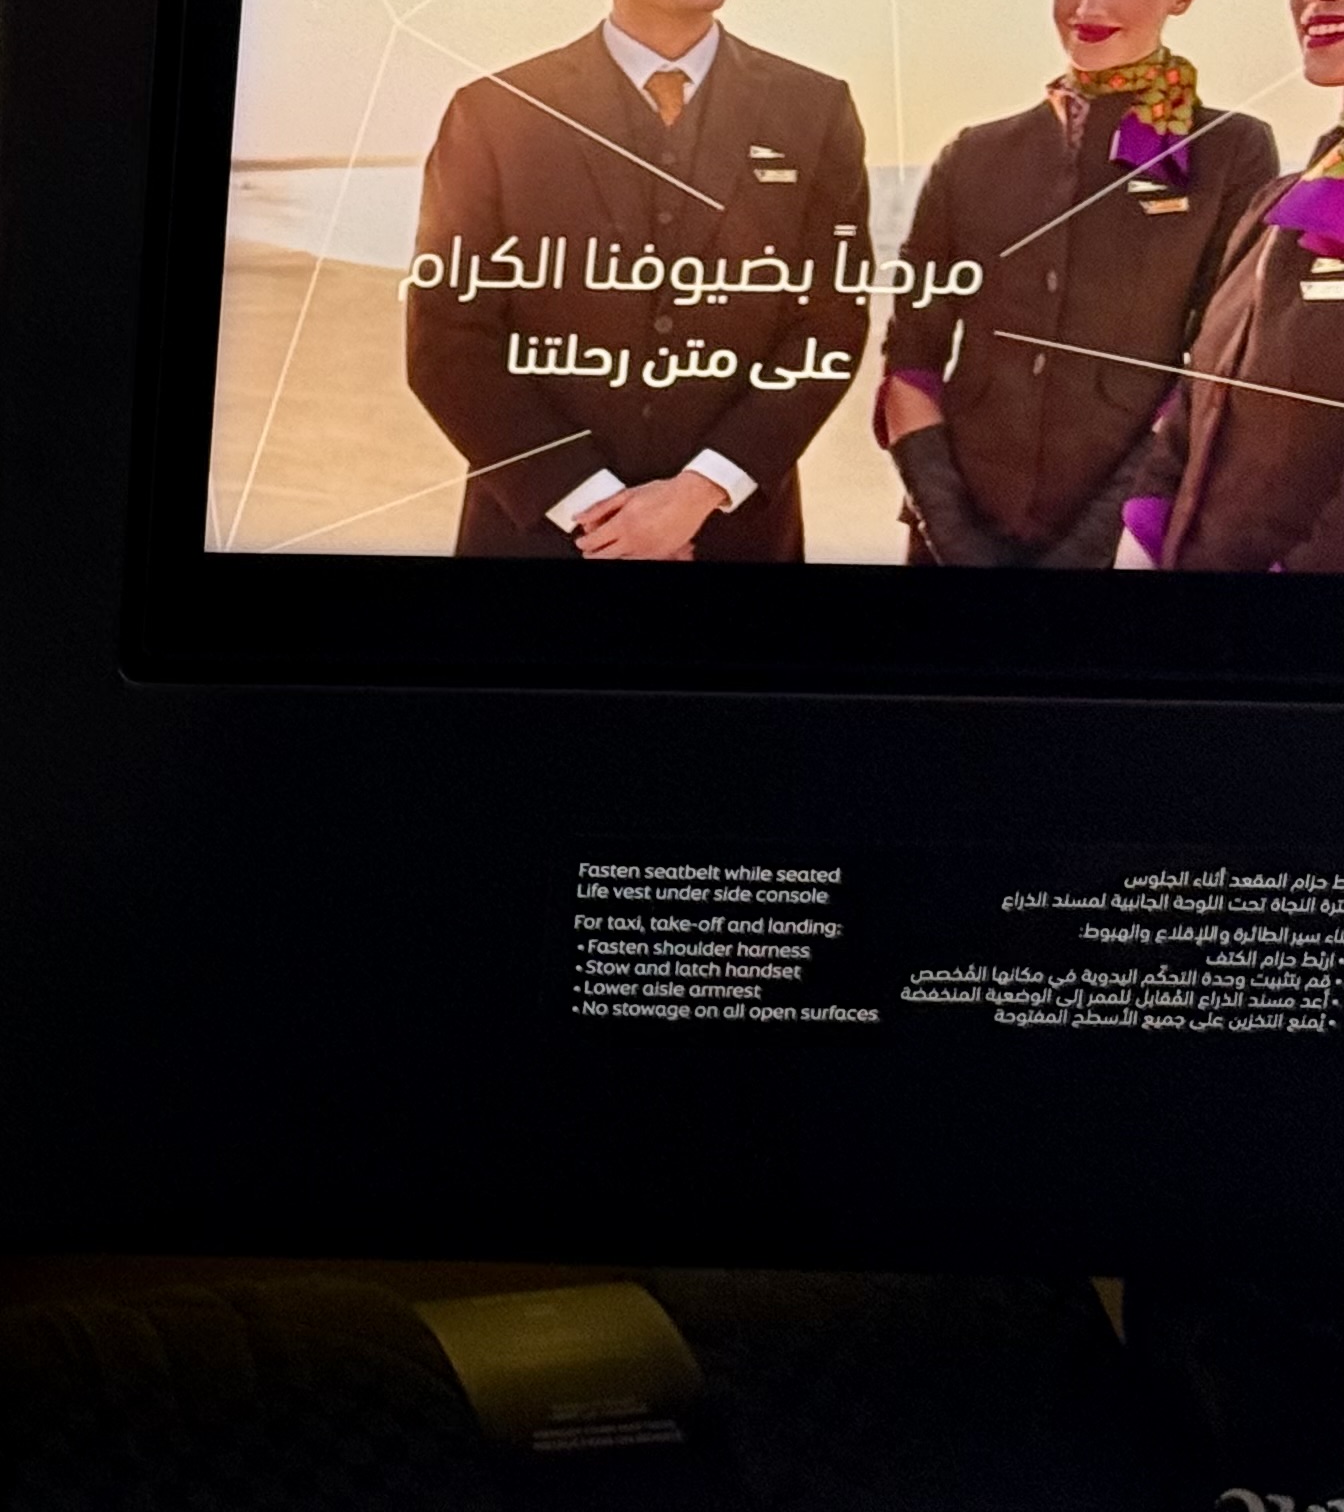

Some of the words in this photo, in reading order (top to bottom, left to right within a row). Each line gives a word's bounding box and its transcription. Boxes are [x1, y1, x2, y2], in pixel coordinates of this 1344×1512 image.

[397, 234, 568, 303] الكرام
[584, 236, 815, 306] بضيوفنا
[505, 332, 630, 388] رحلتنا
[642, 338, 739, 389] متن
[579, 863, 640, 878] Fasten
[645, 865, 720, 880] seatbelt
[725, 865, 773, 881] while
[776, 868, 840, 883] seated
[577, 883, 609, 898] Life
[613, 886, 651, 900] vest
[656, 885, 710, 901] under
[714, 886, 752, 902] side
[756, 888, 828, 904] console
[574, 915, 602, 929] For
[608, 916, 645, 932] taxi,
[651, 916, 725, 932] take-off
[728, 918, 764, 933] and
[768, 918, 843, 938] landing:
[588, 939, 649, 955] Fasten
[653, 940, 733, 957] shoulder
[737, 942, 810, 958] harness
[586, 960, 630, 975] Stow
[634, 961, 670, 976] and
[675, 961, 721, 977] latch
[725, 962, 801, 979] handset
[584, 981, 638, 995] Lower
[643, 982, 685, 997] aisle
[689, 985, 761, 998] armrest
[583, 1001, 608, 1015] No
[613, 1003, 690, 1020] stowage
[695, 1006, 718, 1018] on
[723, 1004, 745, 1018] all
[749, 1007, 796, 1021] open
[801, 1005, 878, 1021] surfaces
